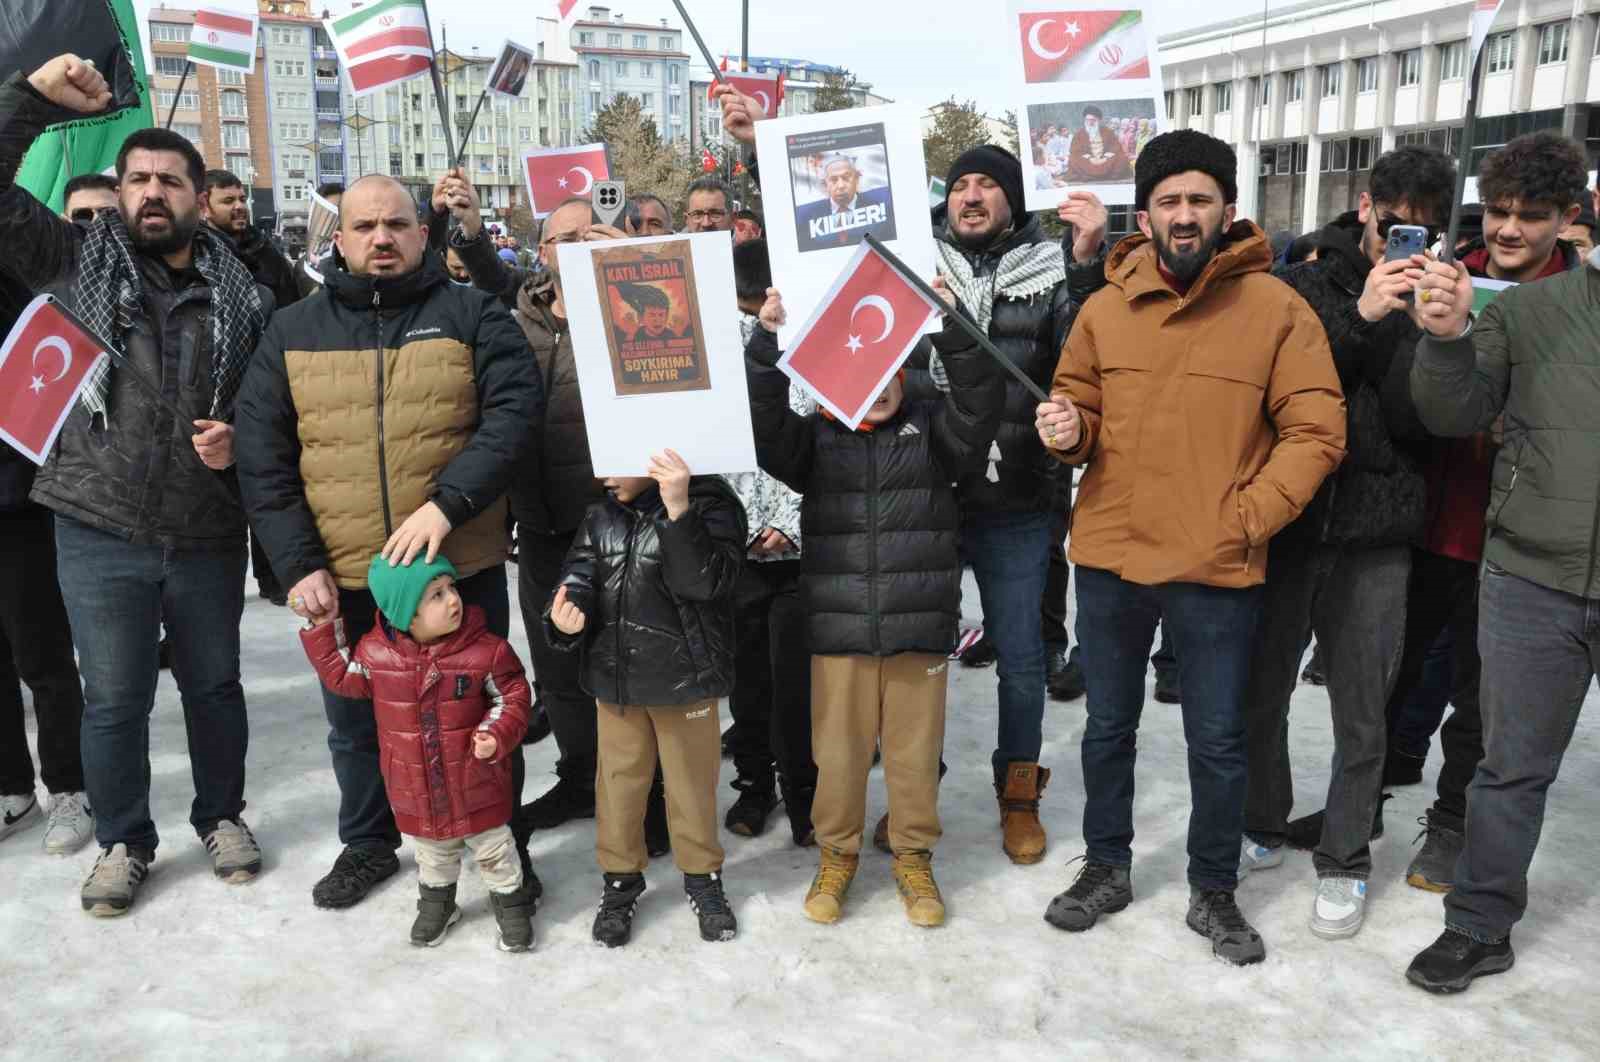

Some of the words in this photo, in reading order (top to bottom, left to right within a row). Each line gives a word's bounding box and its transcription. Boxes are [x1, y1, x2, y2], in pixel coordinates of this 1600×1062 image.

[808, 203, 887, 239] KILLER!
[623, 355, 693, 372] SOYKIRIMA
[640, 369, 679, 382] HAYIR
